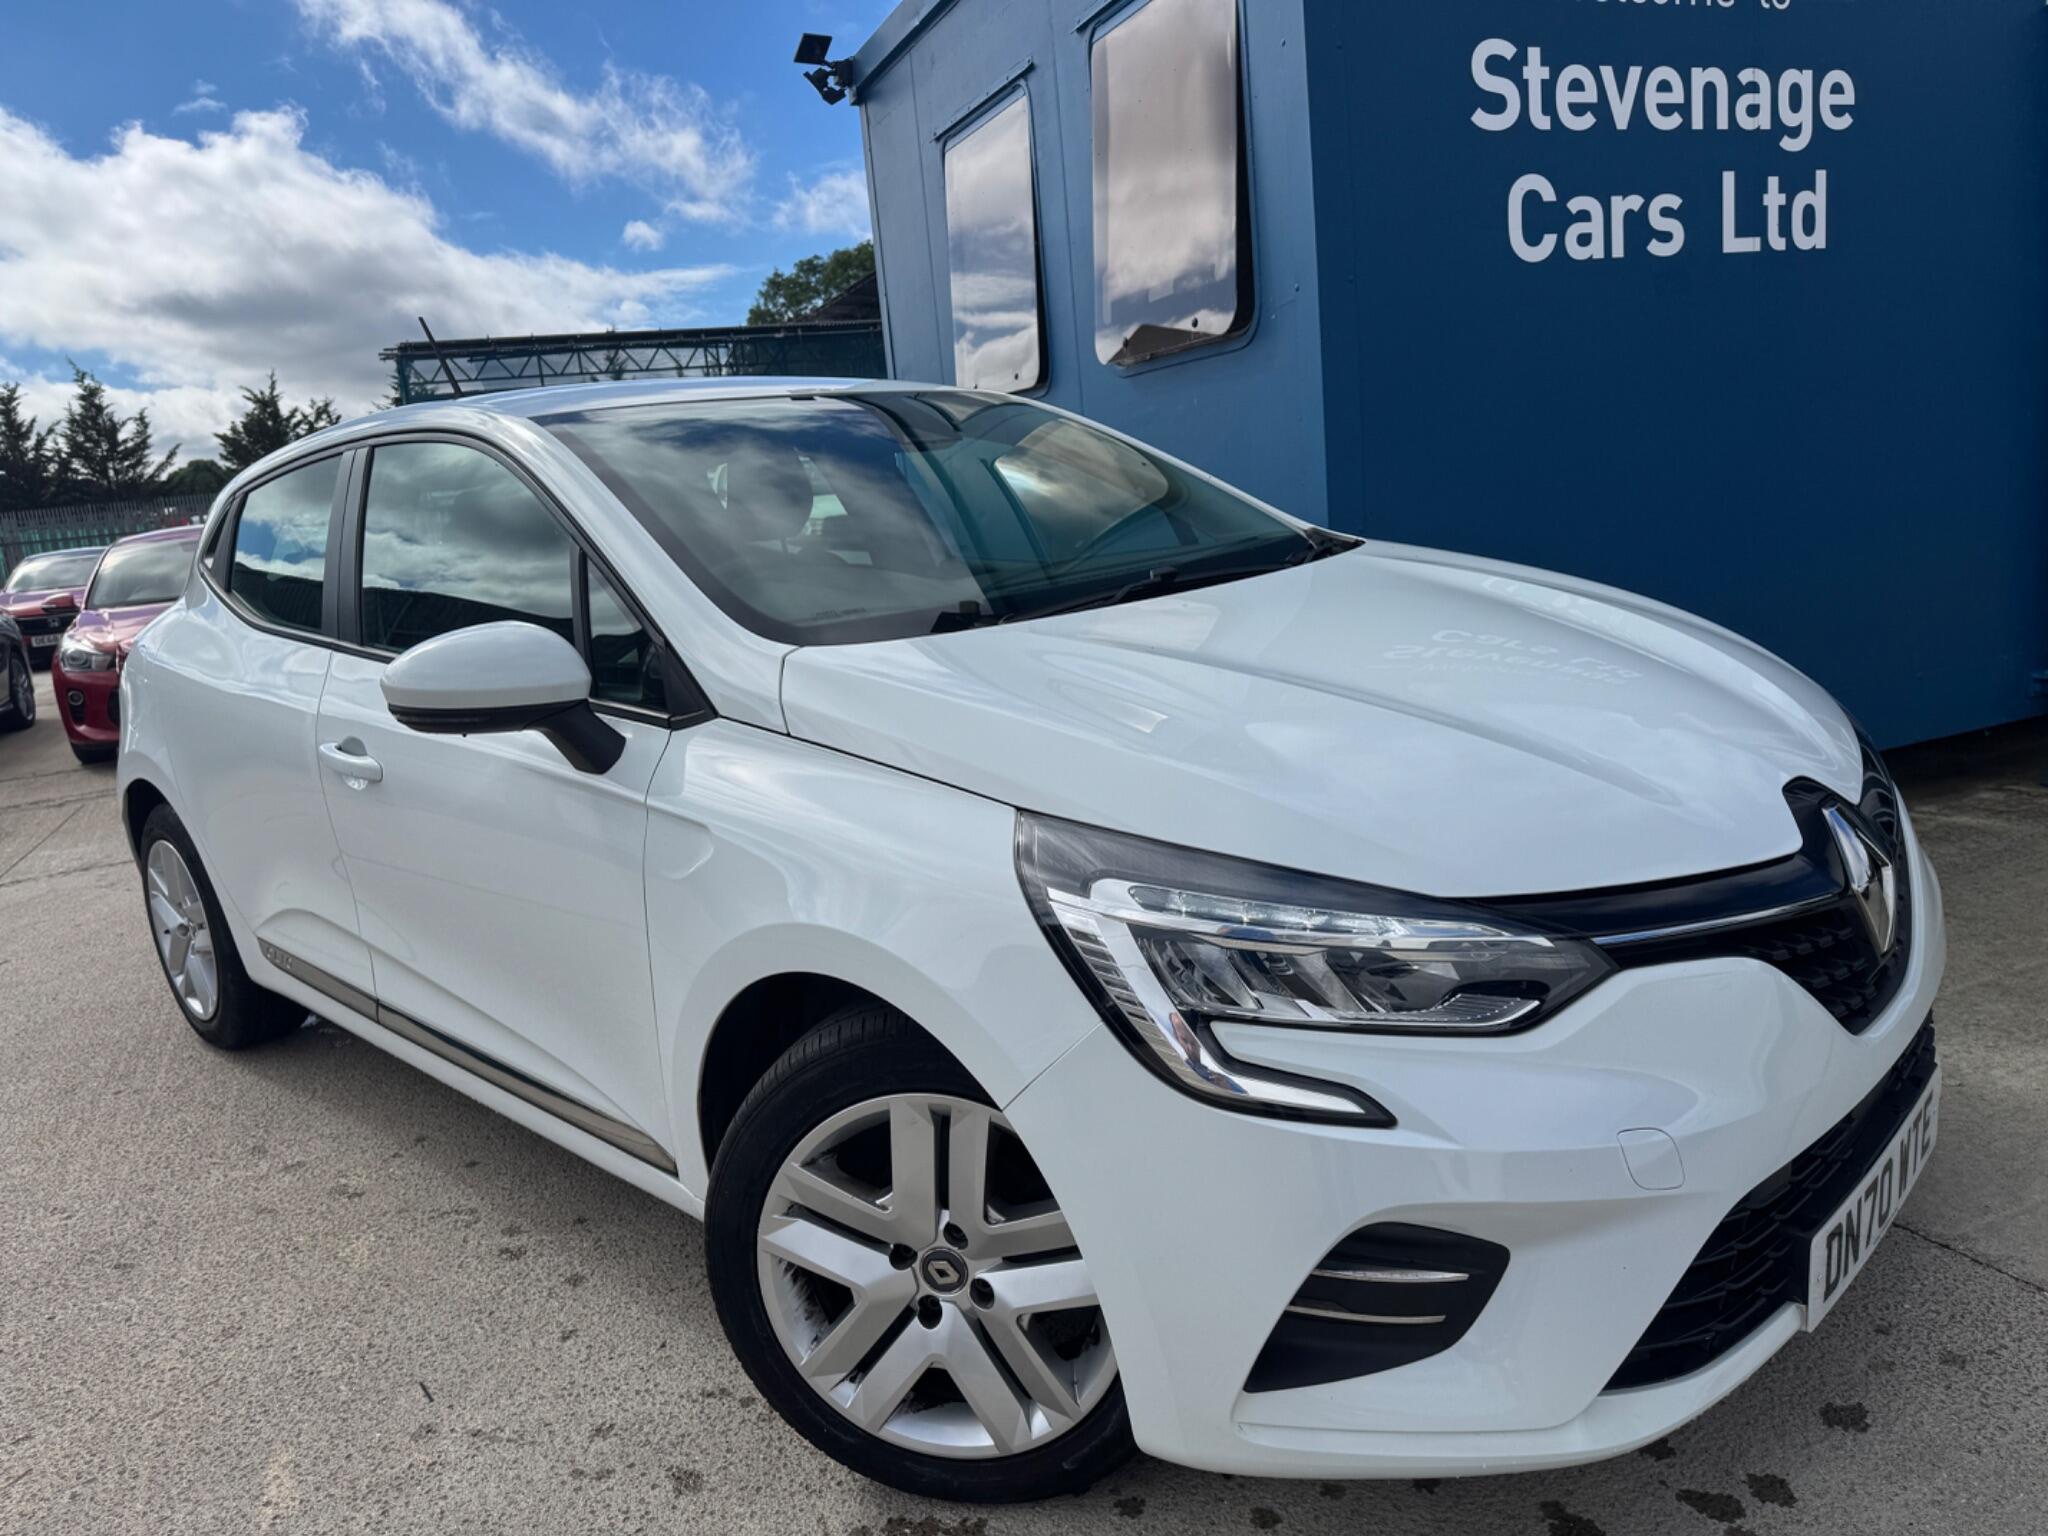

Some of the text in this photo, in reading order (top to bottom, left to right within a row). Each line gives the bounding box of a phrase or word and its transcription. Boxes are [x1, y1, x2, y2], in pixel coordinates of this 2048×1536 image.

[1470, 38, 1855, 152] Stevenage
[1507, 169, 1827, 263] Cars Ltd
[1823, 1157, 1893, 1303] DN70
